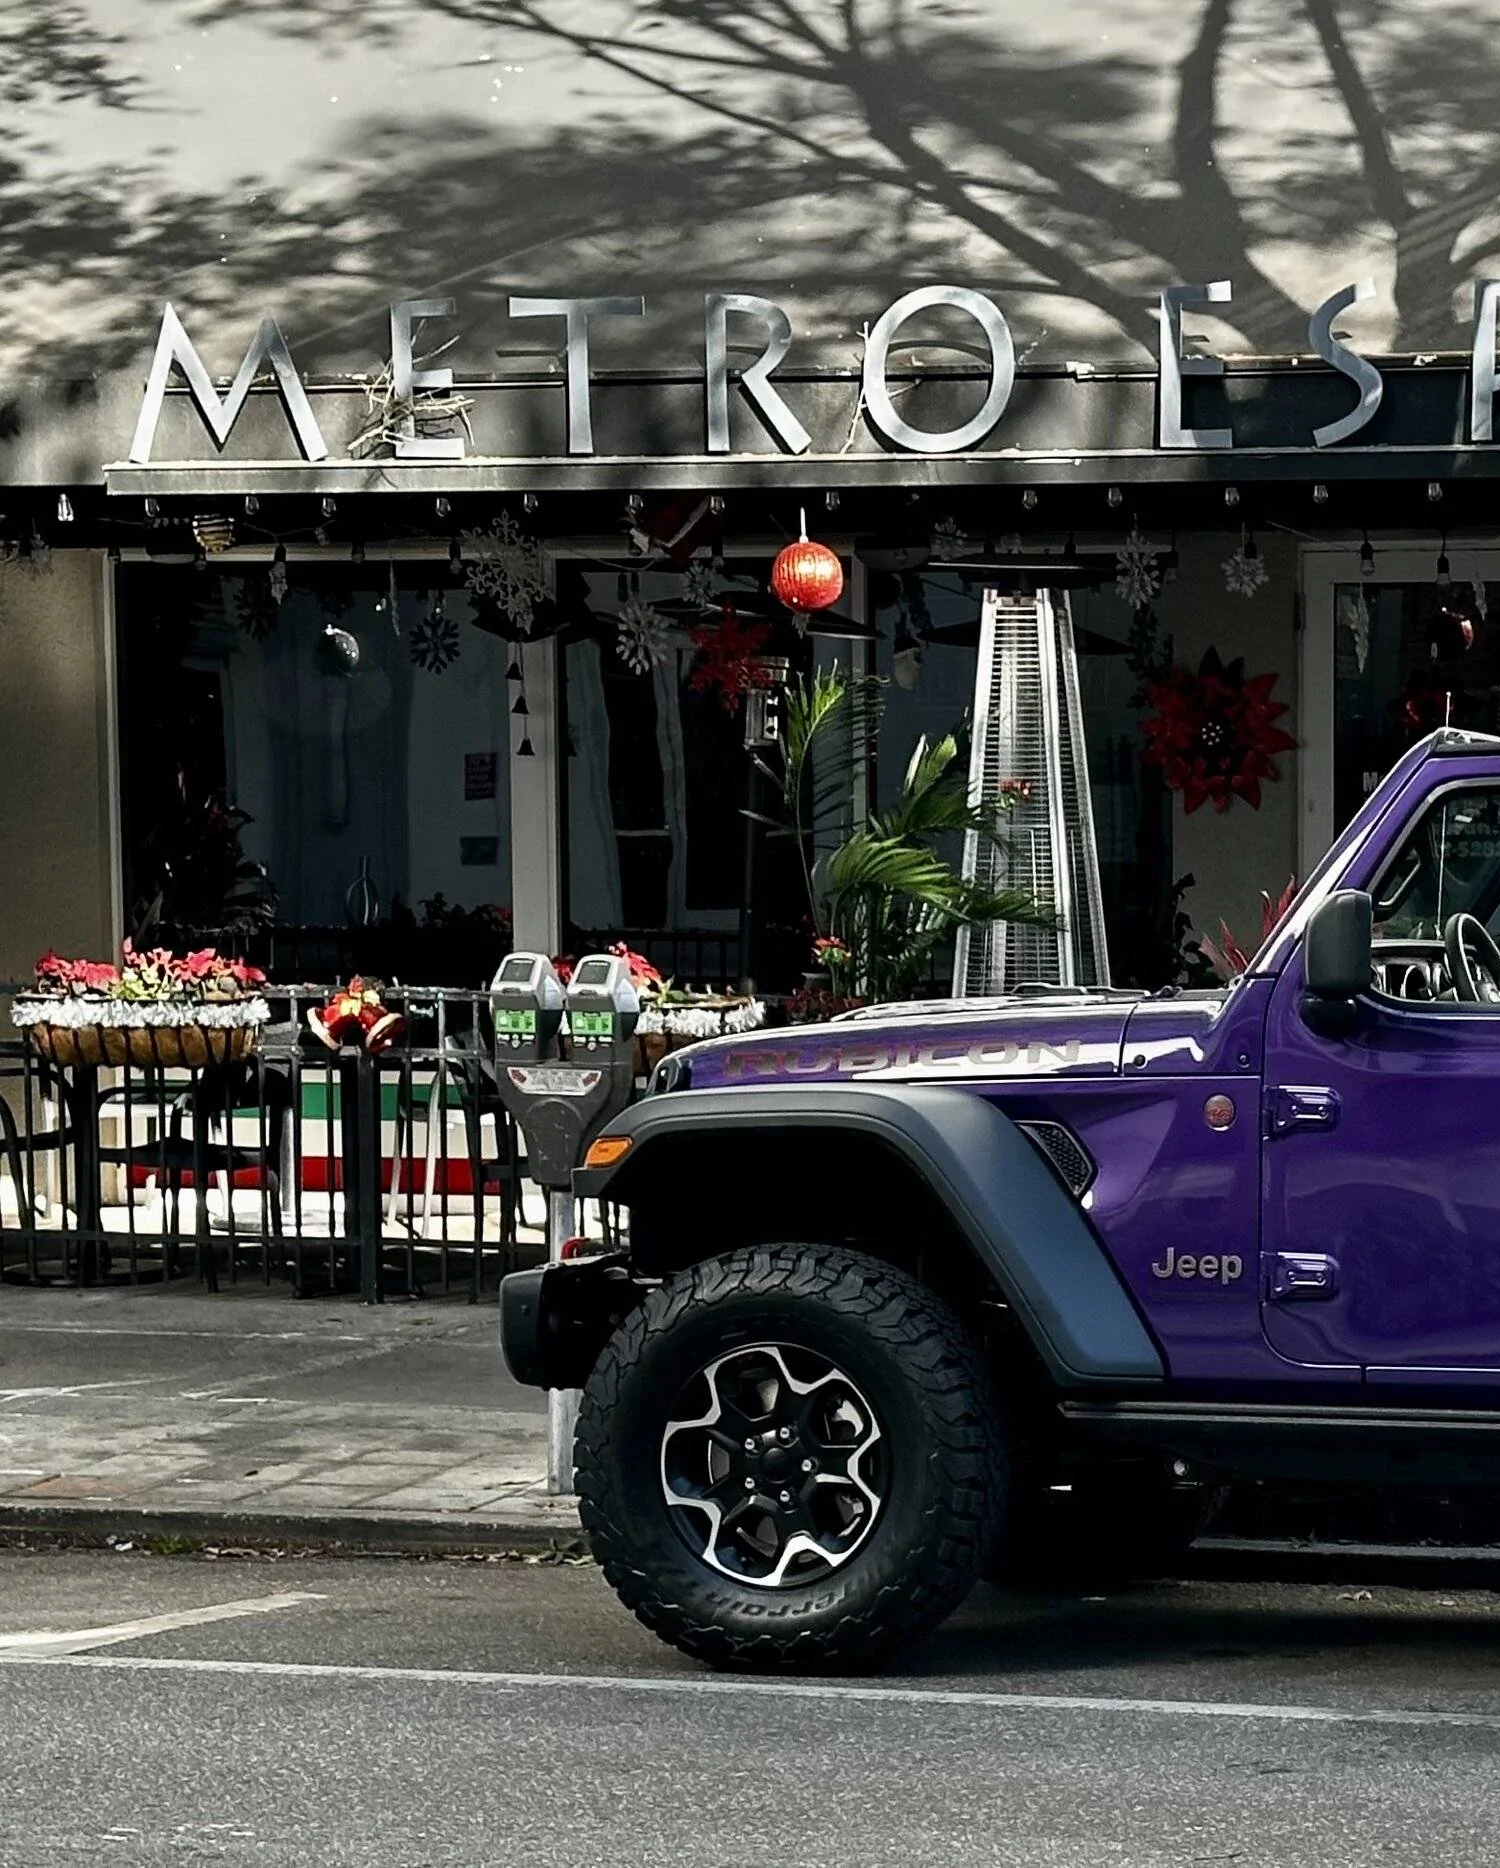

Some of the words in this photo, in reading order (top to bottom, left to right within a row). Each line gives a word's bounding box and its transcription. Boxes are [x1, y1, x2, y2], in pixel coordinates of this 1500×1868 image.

[129, 284, 1015, 463] METRO
[725, 1040, 1084, 1077] RUBICON
[1152, 1247, 1242, 1285] Jeep
